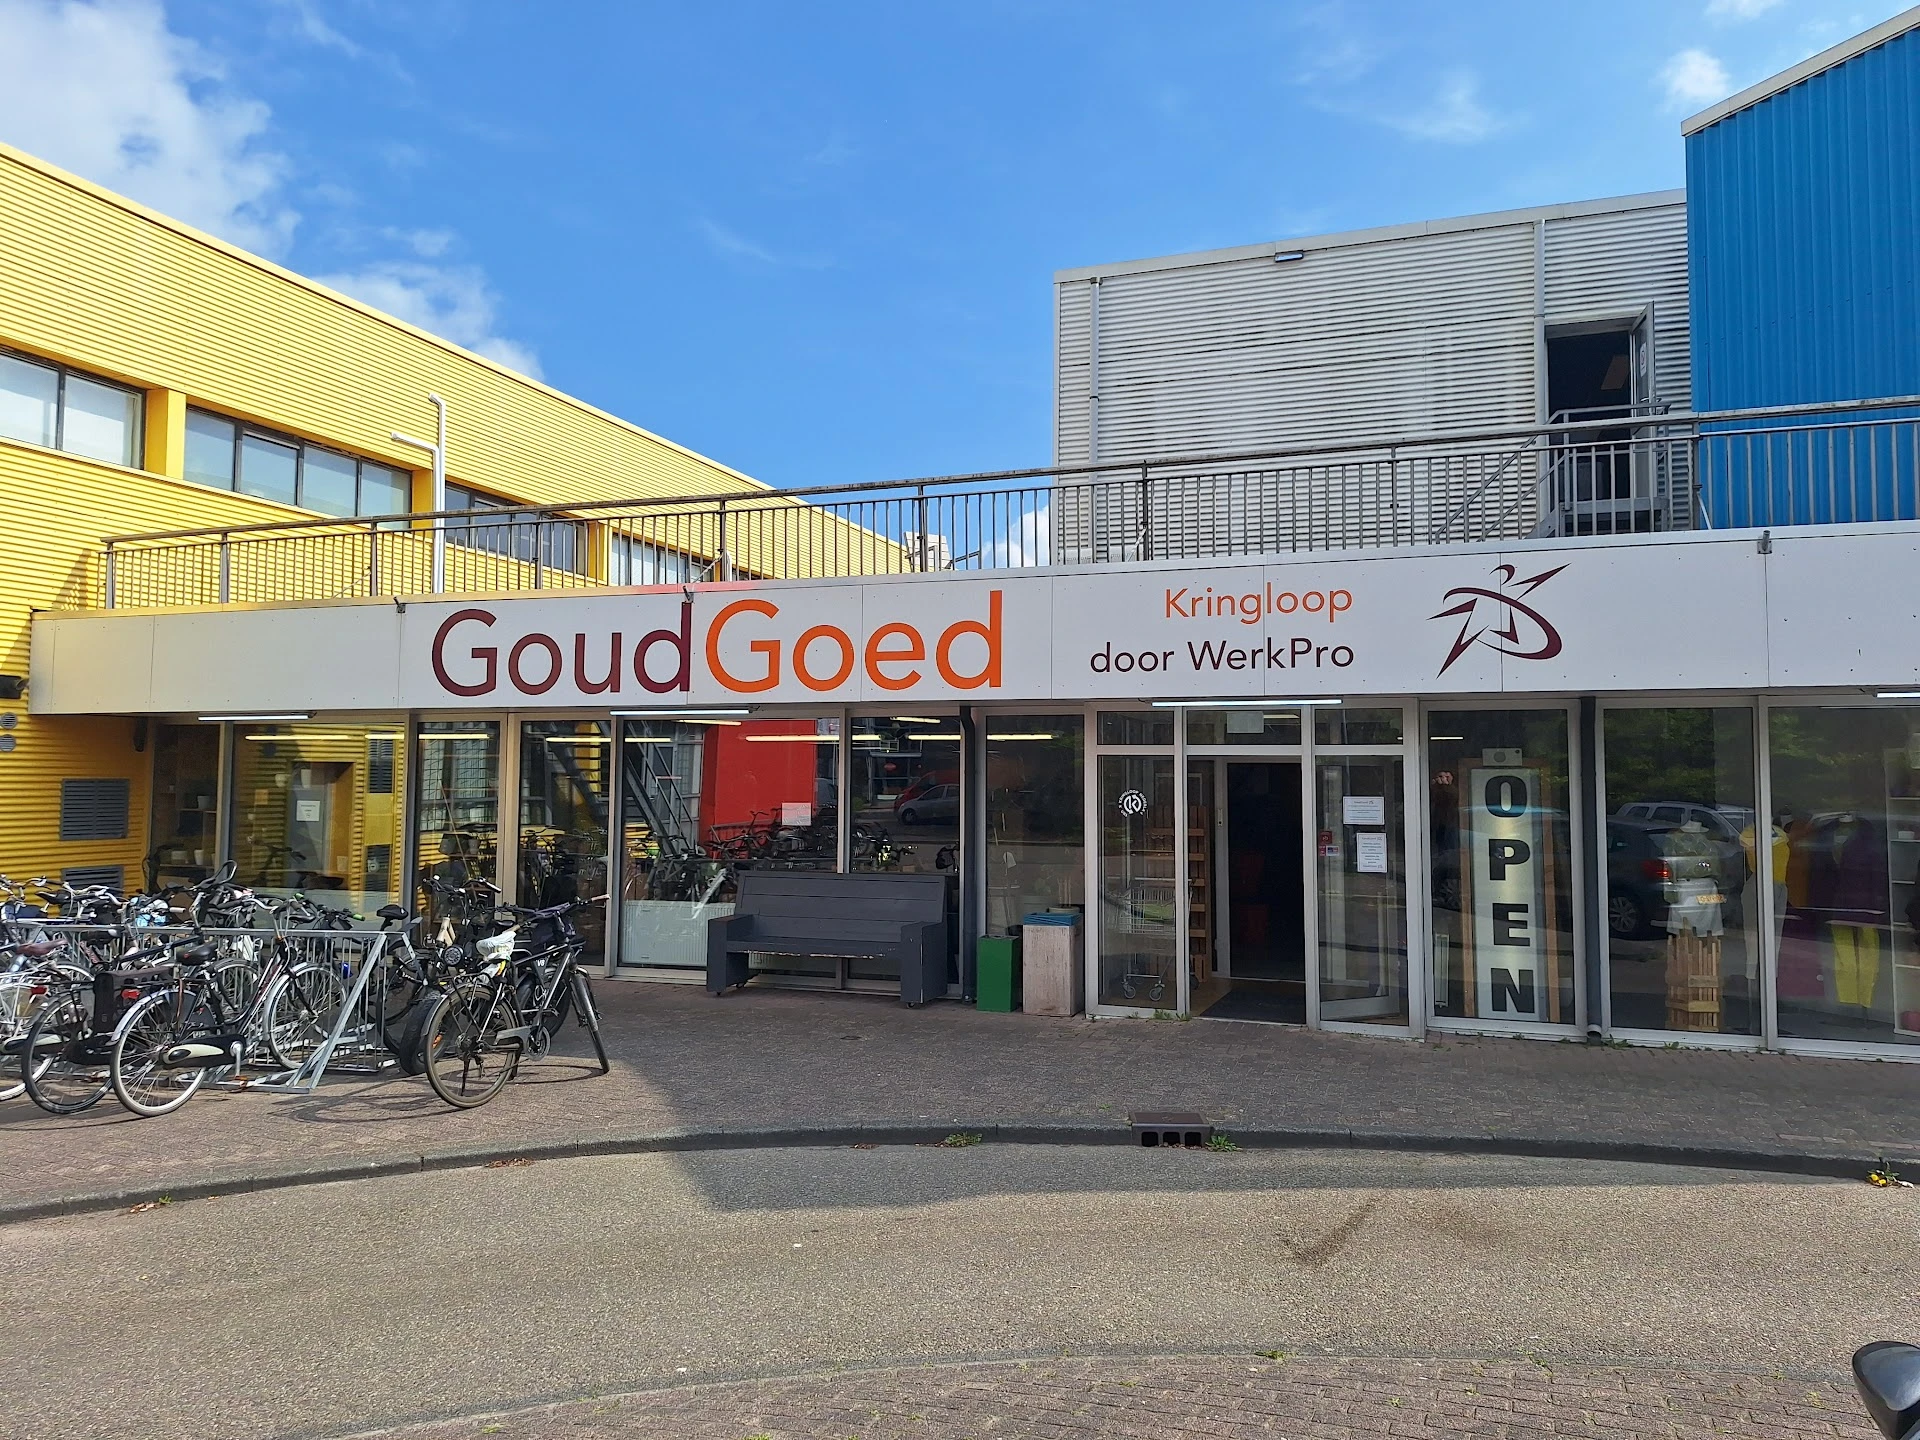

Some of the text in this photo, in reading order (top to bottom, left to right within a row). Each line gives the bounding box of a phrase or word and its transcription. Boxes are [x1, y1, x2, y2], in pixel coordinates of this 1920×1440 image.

[1165, 582, 1353, 625] Kringloop
[431, 590, 1003, 697] GoudGoed
[1090, 636, 1354, 673] door WerkPro
[1485, 775, 1535, 1013] OPEN
